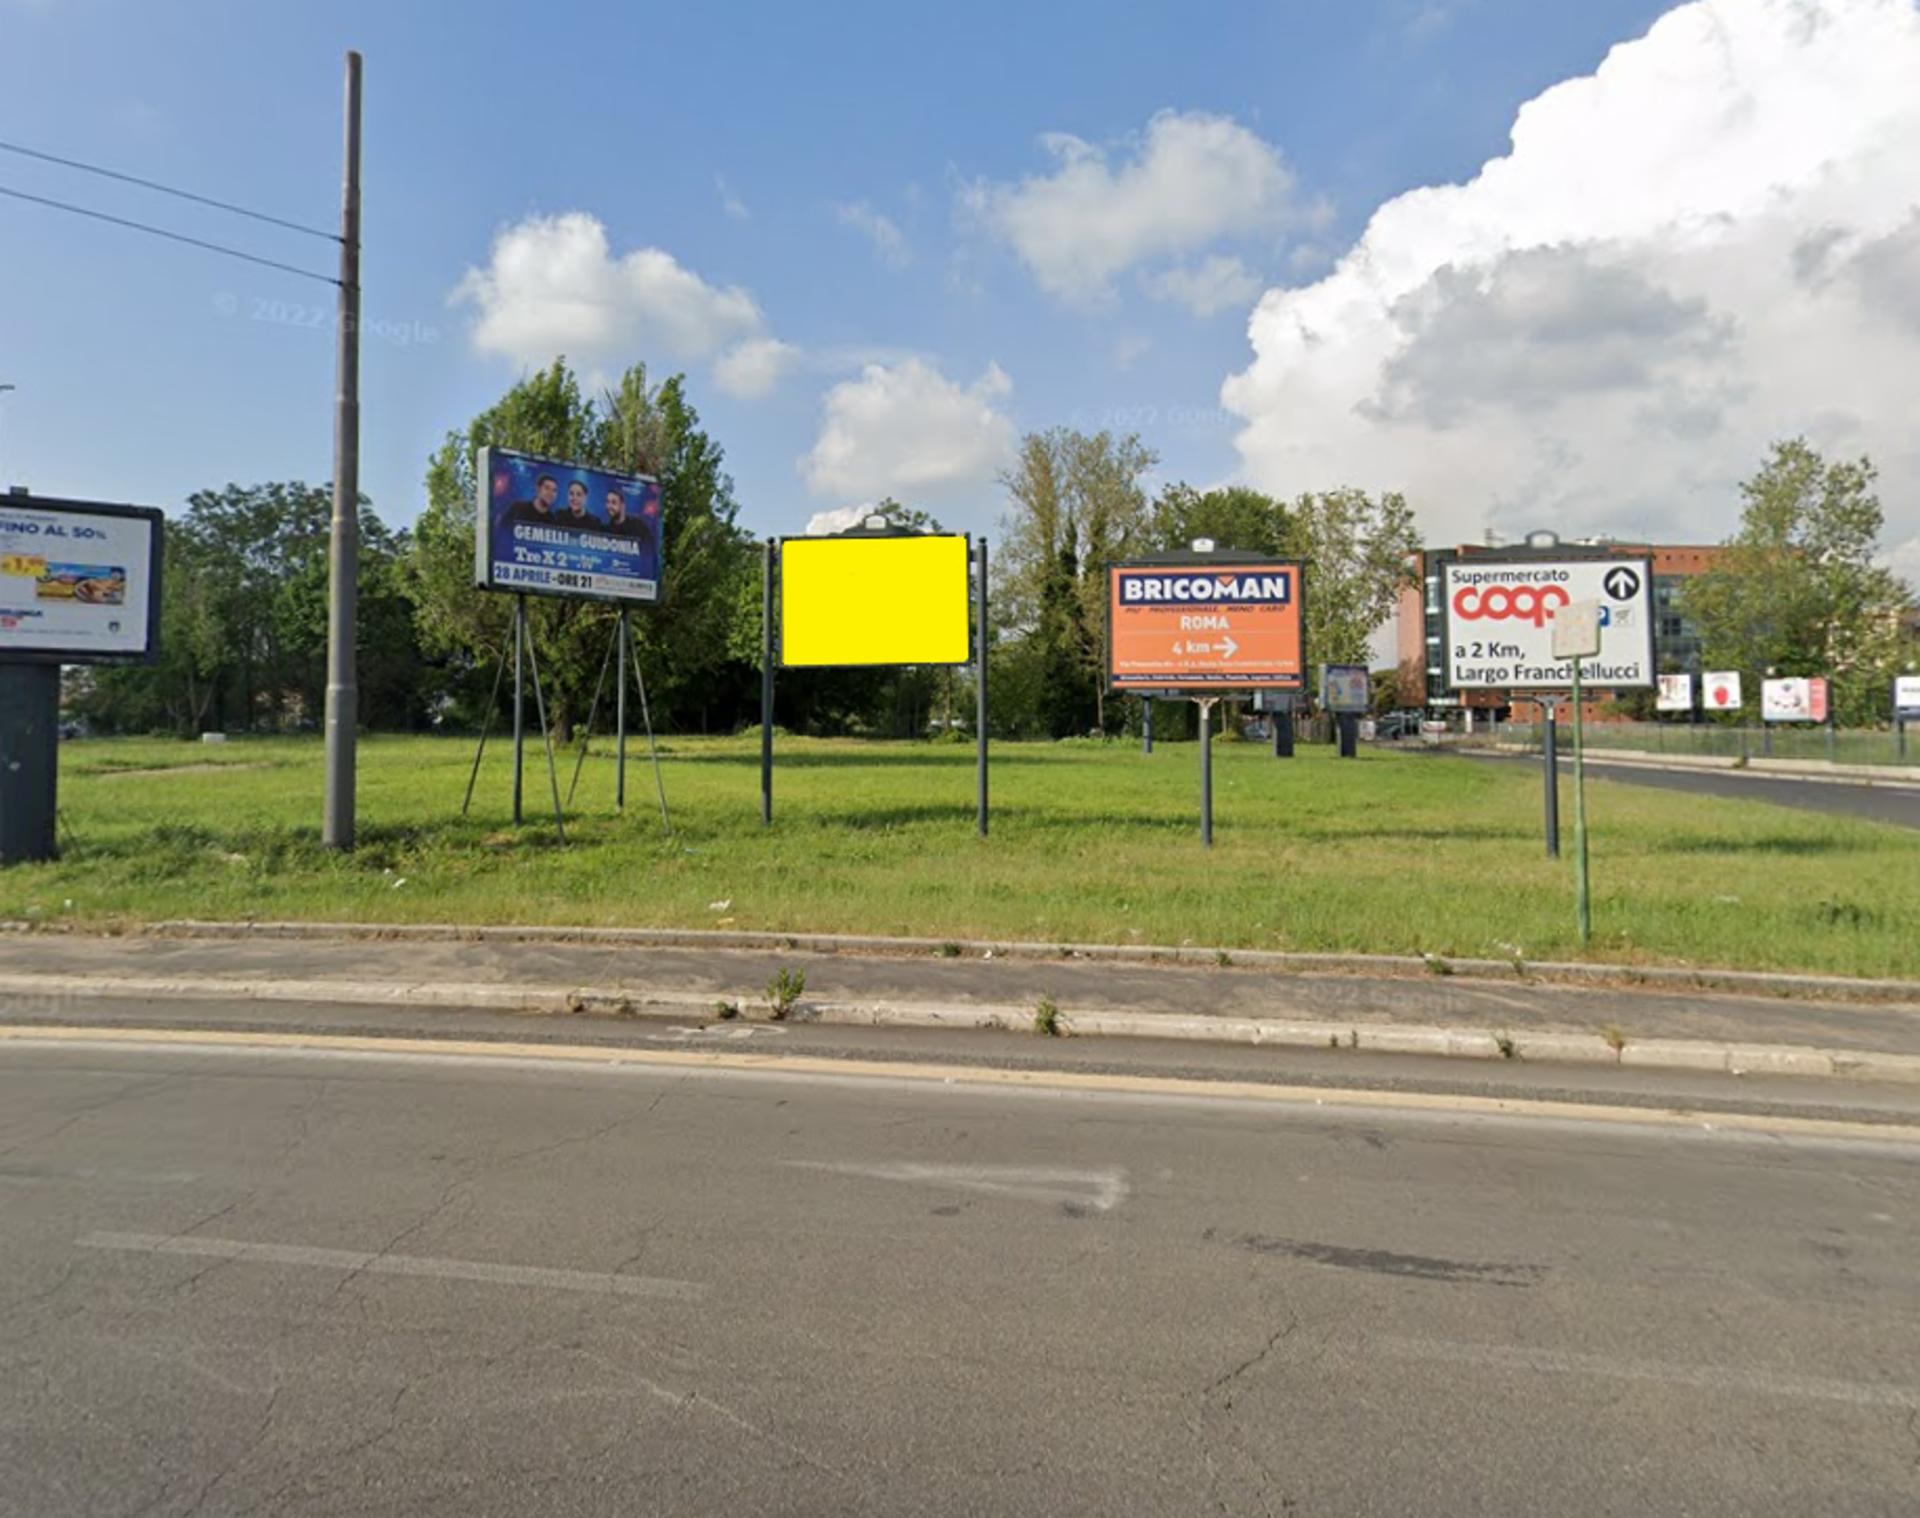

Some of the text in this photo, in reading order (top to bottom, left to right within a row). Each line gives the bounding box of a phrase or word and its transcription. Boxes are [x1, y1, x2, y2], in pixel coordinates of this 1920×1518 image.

[44, 524, 68, 537] AL
[513, 524, 570, 546] GEMELLI
[580, 533, 640, 556] GUIDONIA
[557, 551, 569, 568] 2
[495, 565, 510, 580] 28
[513, 567, 550, 585] APRILE
[581, 575, 593, 589] 21
[1452, 569, 1570, 586] Supermercato
[1124, 577, 1285, 600] BRICOMAN
[1453, 584, 1570, 628] coop
[1180, 615, 1229, 630] ROMA
[1172, 640, 1210, 655] 4 km
[1455, 642, 1526, 660] a 2 Km,
[1456, 665, 1509, 684] Largo
